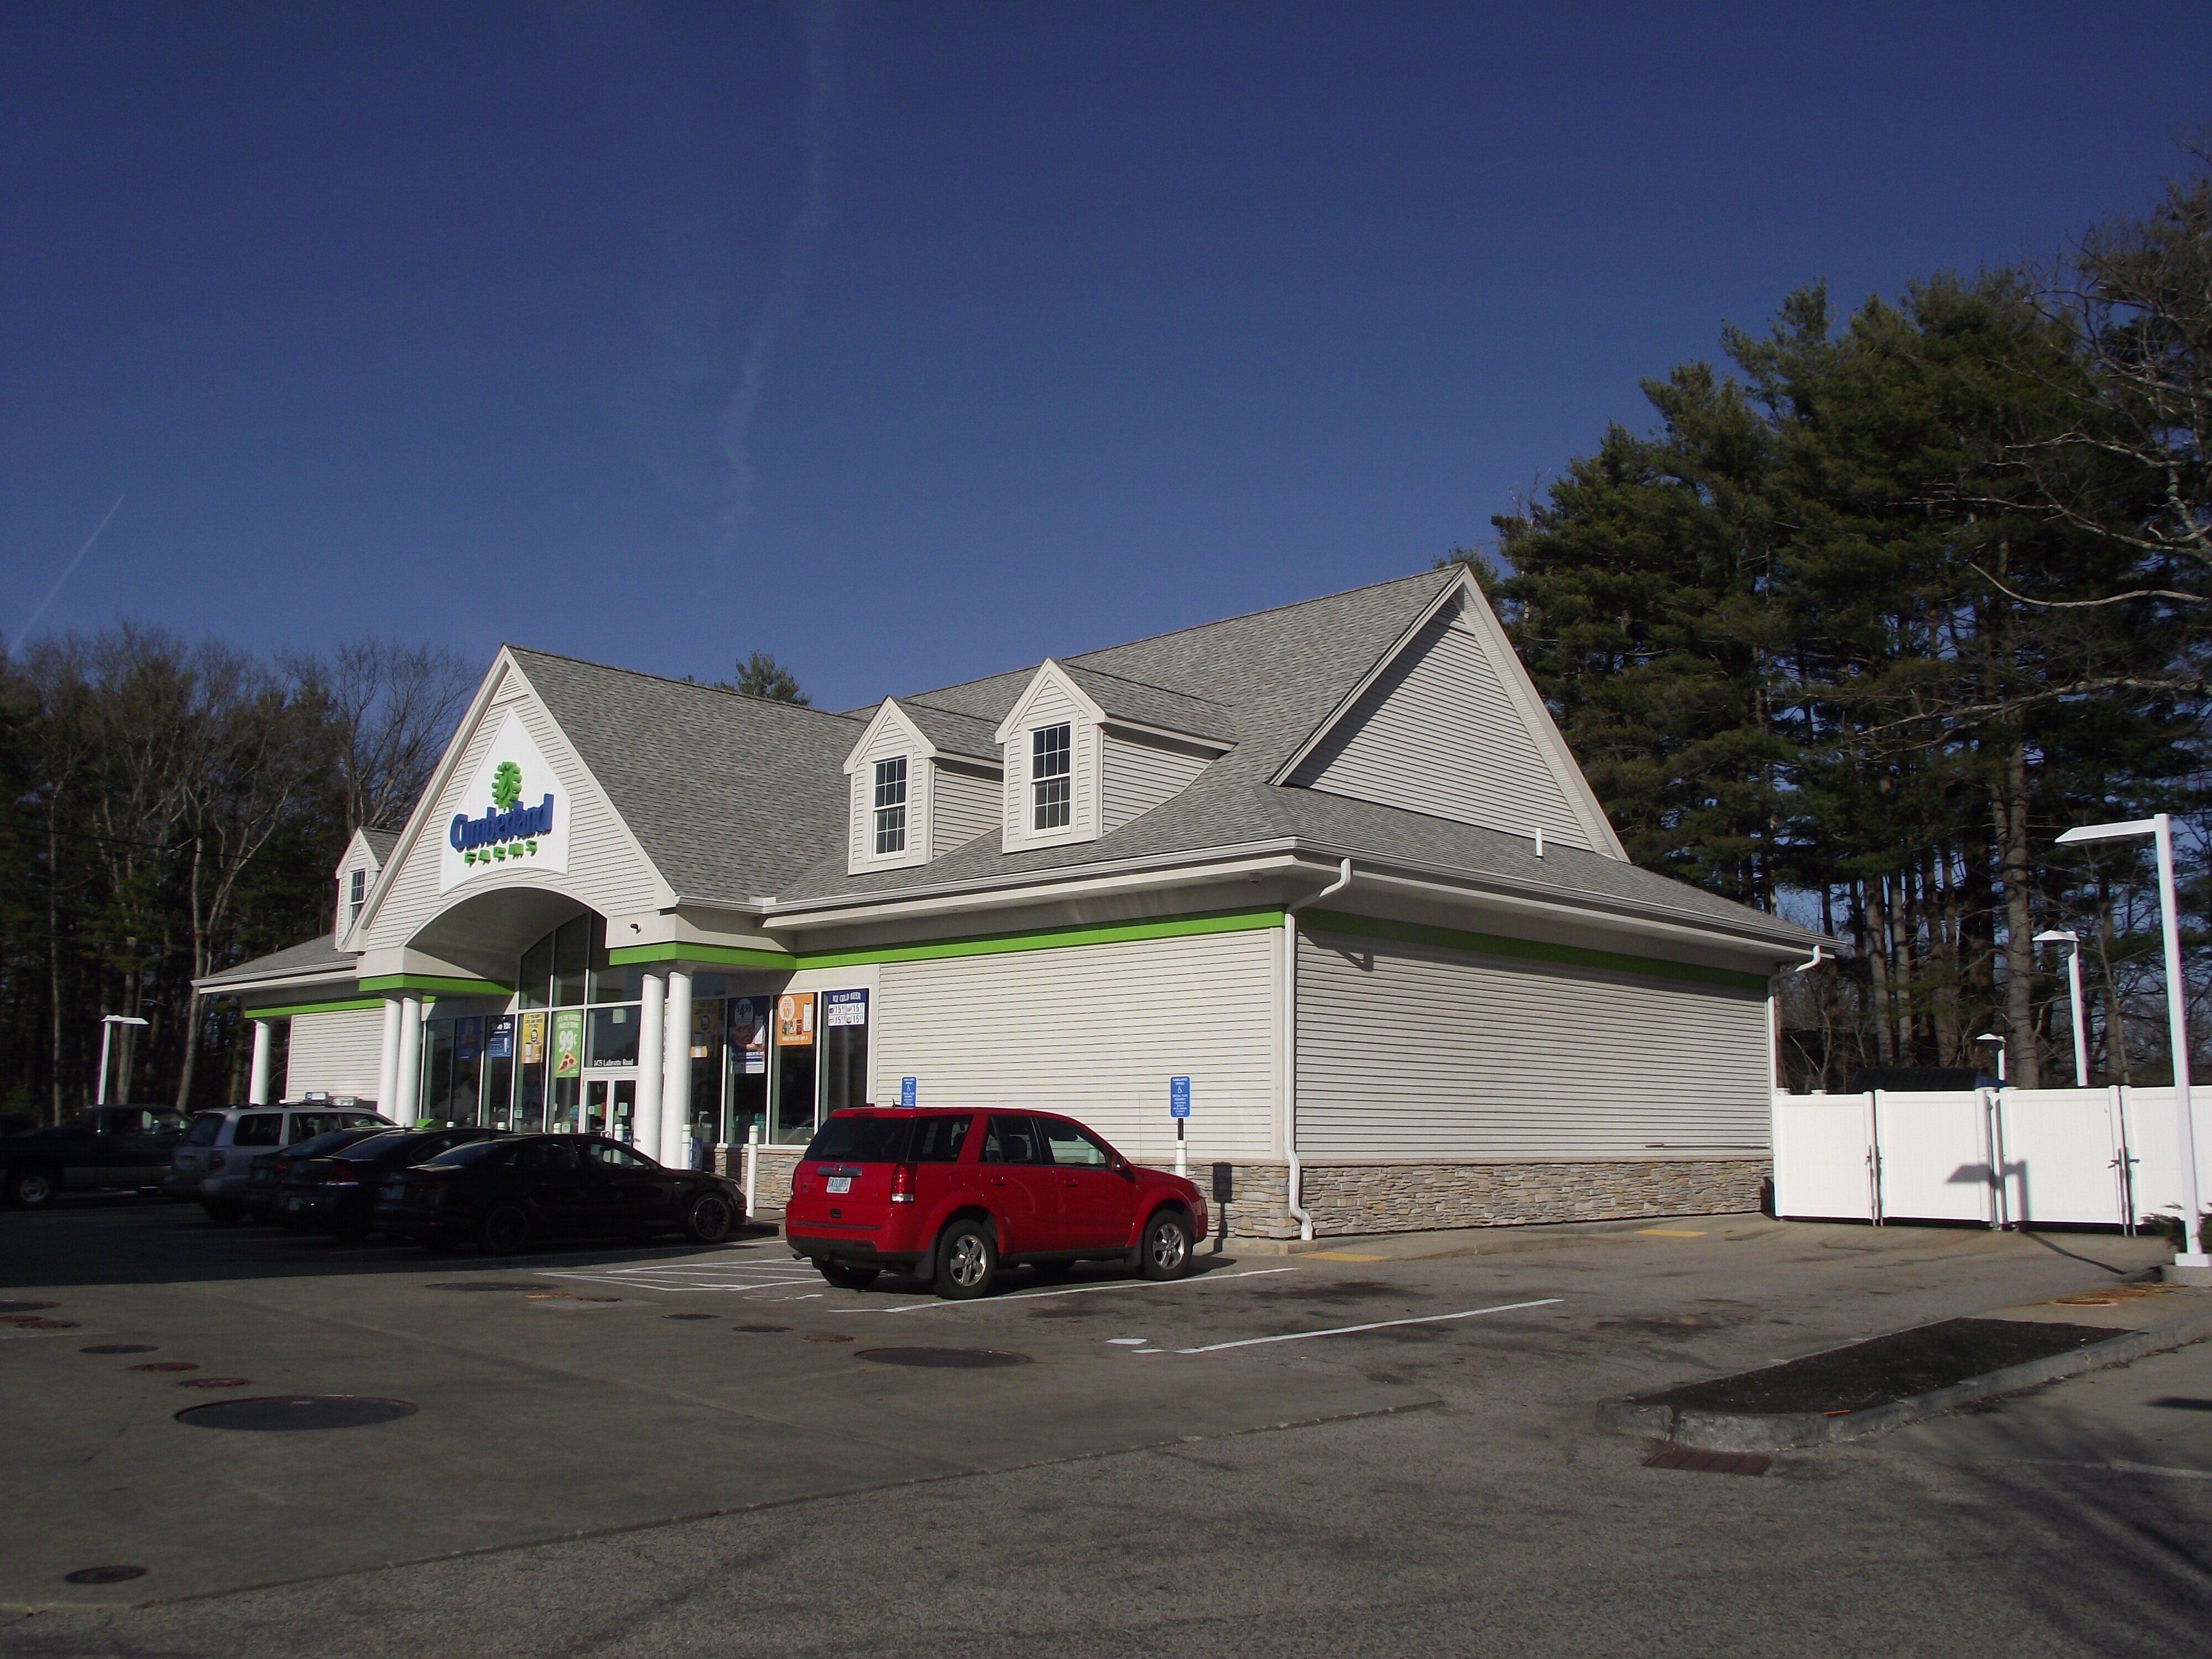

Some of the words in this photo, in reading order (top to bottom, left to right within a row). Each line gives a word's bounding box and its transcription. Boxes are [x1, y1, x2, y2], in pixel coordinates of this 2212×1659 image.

[450, 794, 554, 851] Cumberland
[465, 840, 538, 864] FARMS
[839, 993, 849, 1002] COLD
[850, 992, 861, 1000] BEER
